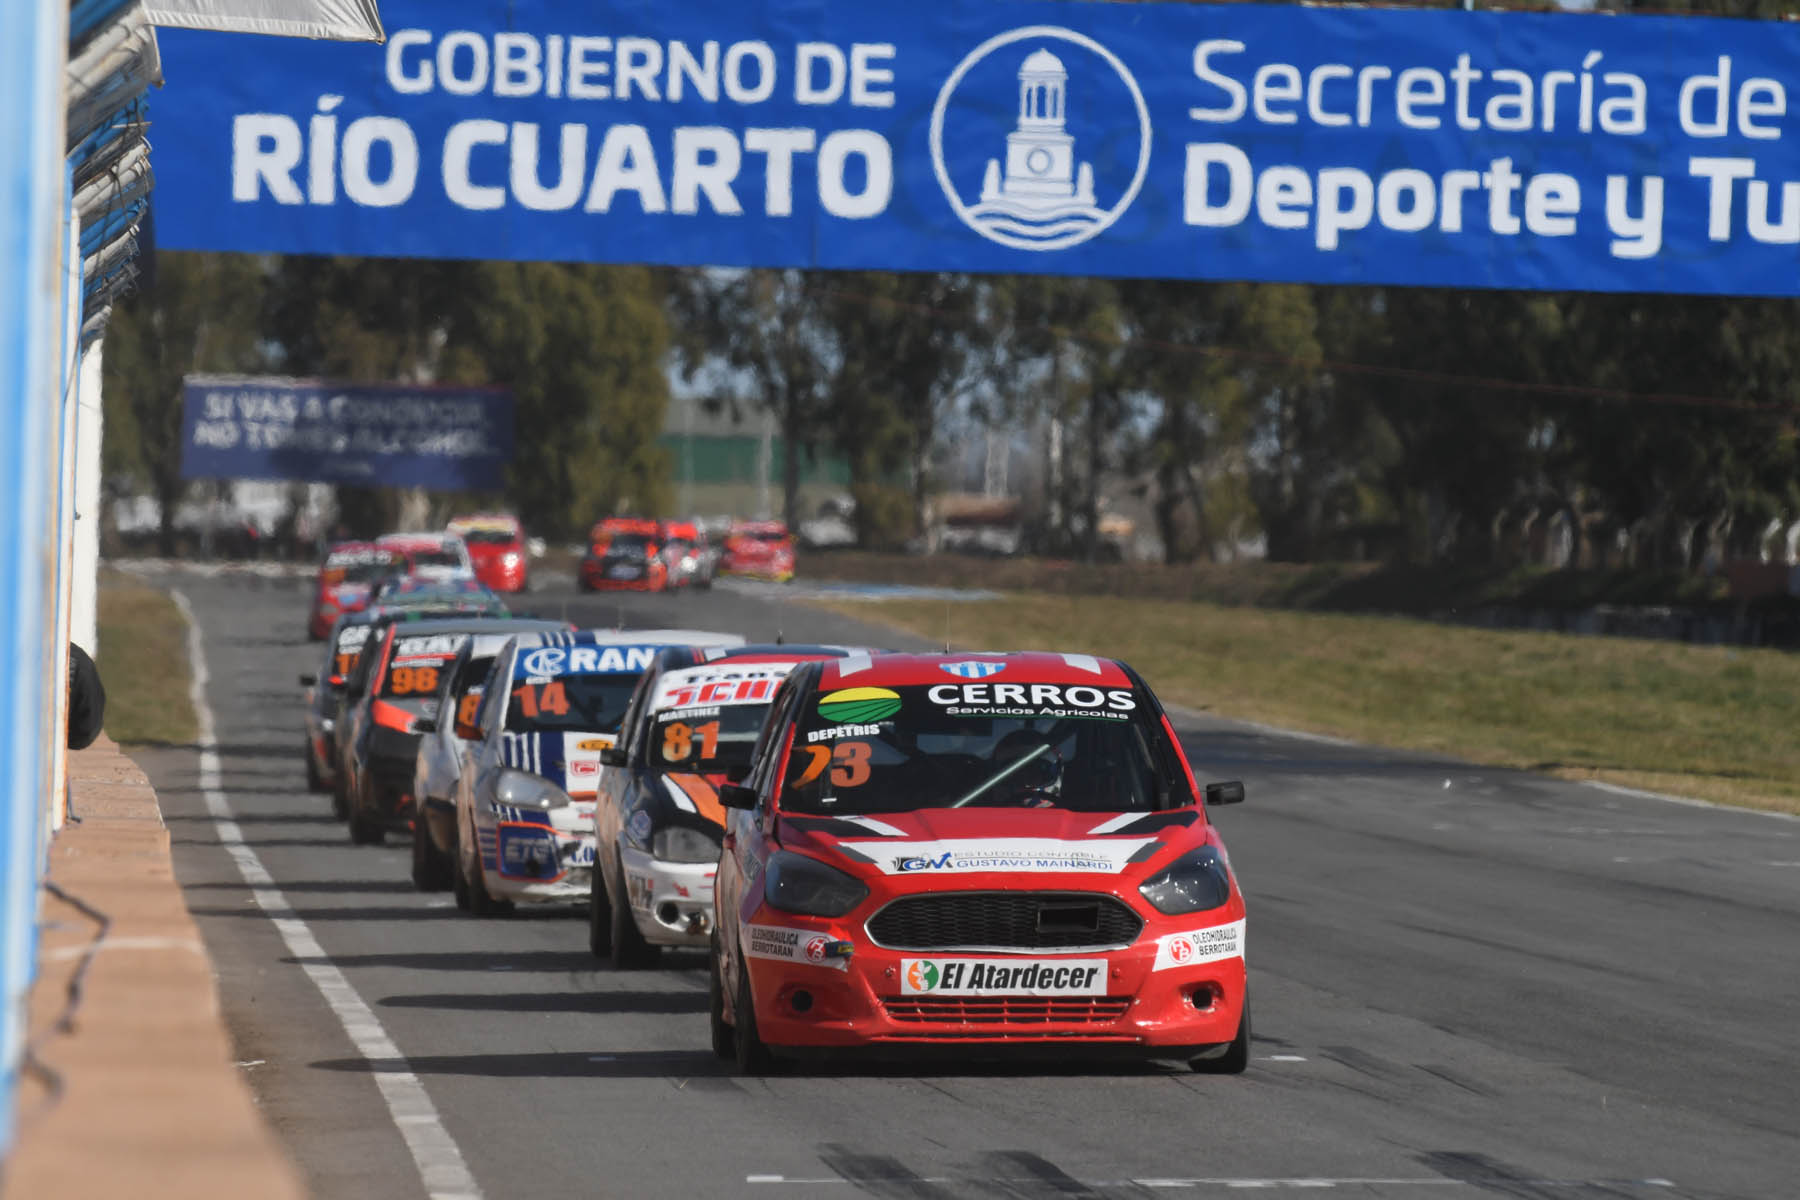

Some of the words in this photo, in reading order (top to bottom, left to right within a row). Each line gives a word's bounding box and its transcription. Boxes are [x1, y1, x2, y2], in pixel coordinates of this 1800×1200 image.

[385, 29, 776, 104] GOBIERNO
[794, 41, 896, 108] DE
[1190, 38, 1648, 135] Secretaría
[1678, 55, 1786, 139] de
[231, 93, 421, 207] RÍO
[441, 119, 895, 219] CUARTO
[1183, 142, 1581, 251] Deporte
[1605, 174, 1665, 259] y
[391, 666, 439, 695] 98
[927, 683, 1137, 711] CERROS
[512, 681, 570, 718] 14
[945, 706, 1035, 716] Servicios
[662, 720, 720, 763] 81
[807, 723, 881, 743] DEPETRIS
[955, 858, 1032, 869] GUSTAVO
[1036, 859, 1113, 871] MAINARDI
[939, 962, 966, 990] El
[967, 962, 1099, 990] Atardecer
